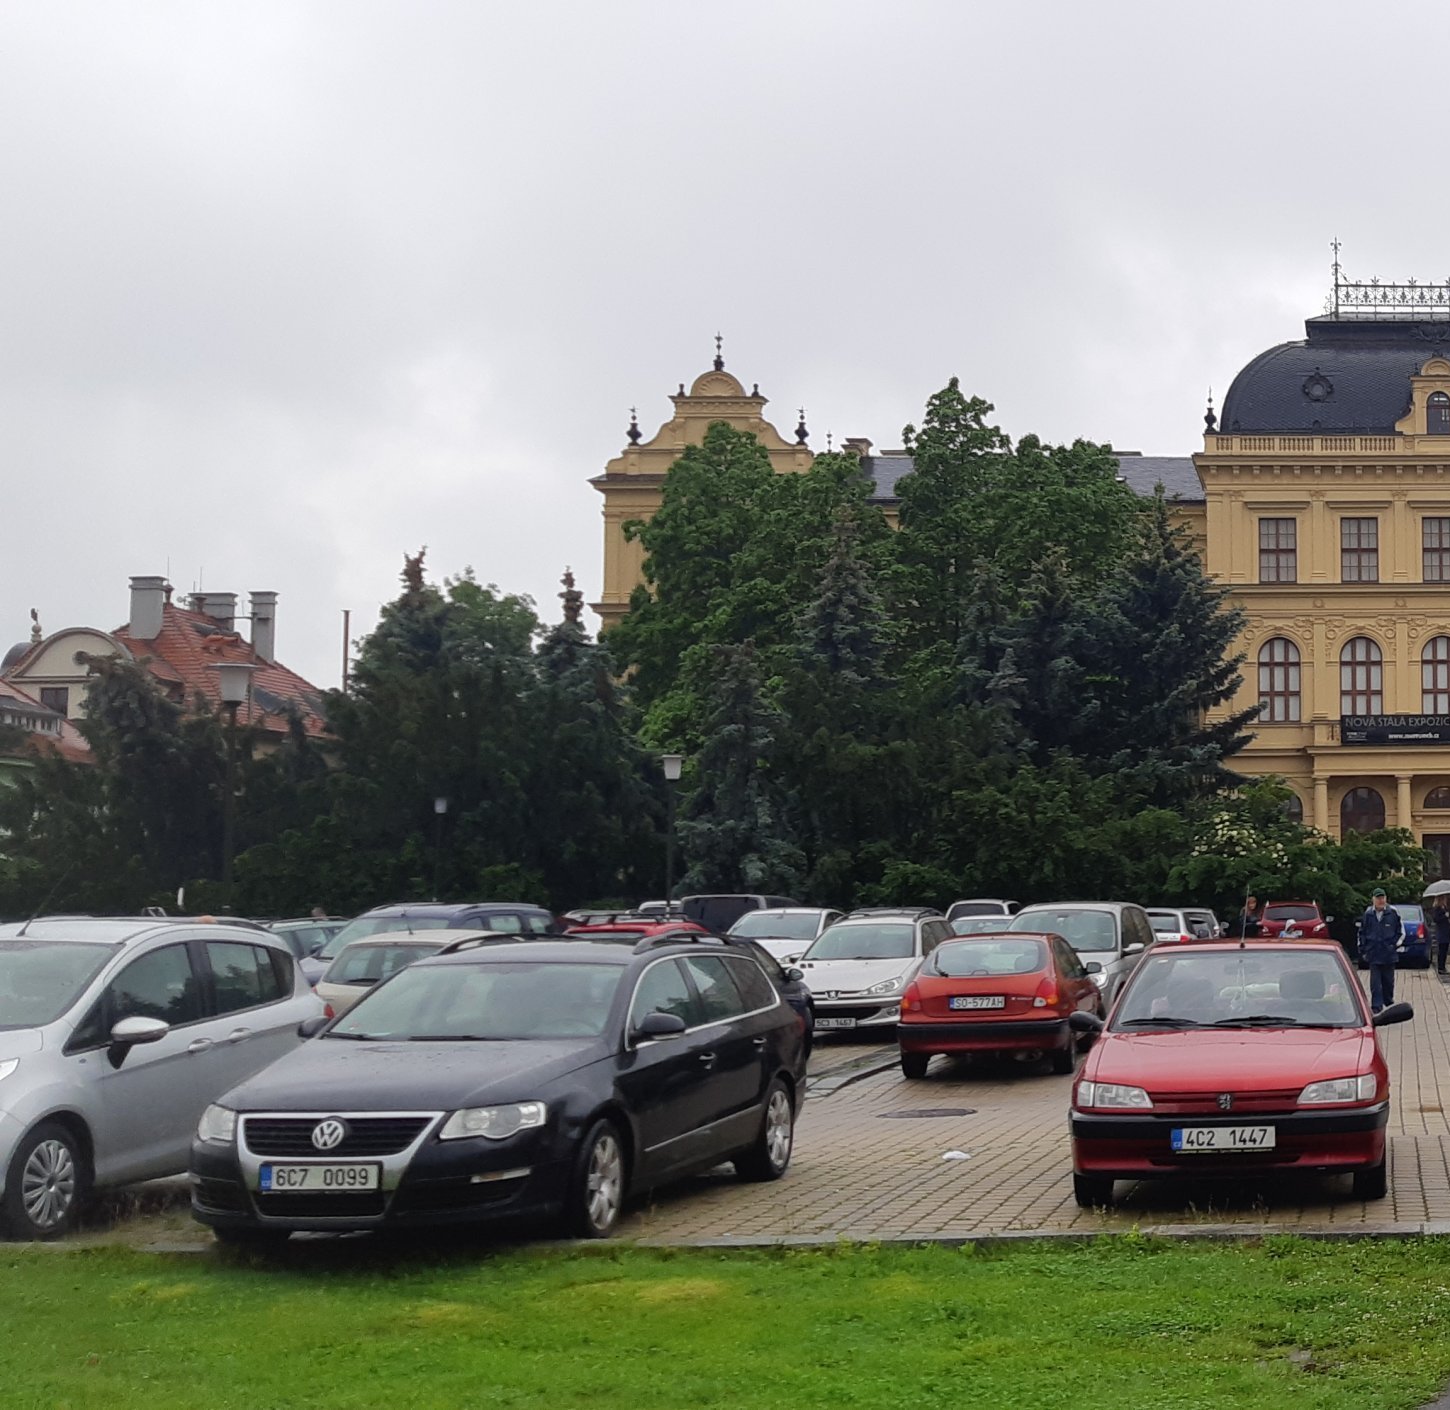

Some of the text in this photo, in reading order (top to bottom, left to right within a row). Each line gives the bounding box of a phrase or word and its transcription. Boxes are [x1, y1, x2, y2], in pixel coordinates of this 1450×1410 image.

[1345, 716, 1376, 727] NOVÁ
[1378, 716, 1406, 727] STÁLÁ
[955, 996, 1003, 1008] SO-577AH
[1186, 1130, 1216, 1147] 4C2
[1229, 1128, 1268, 1146] 1447
[275, 1167, 369, 1187] 6C7 0099
